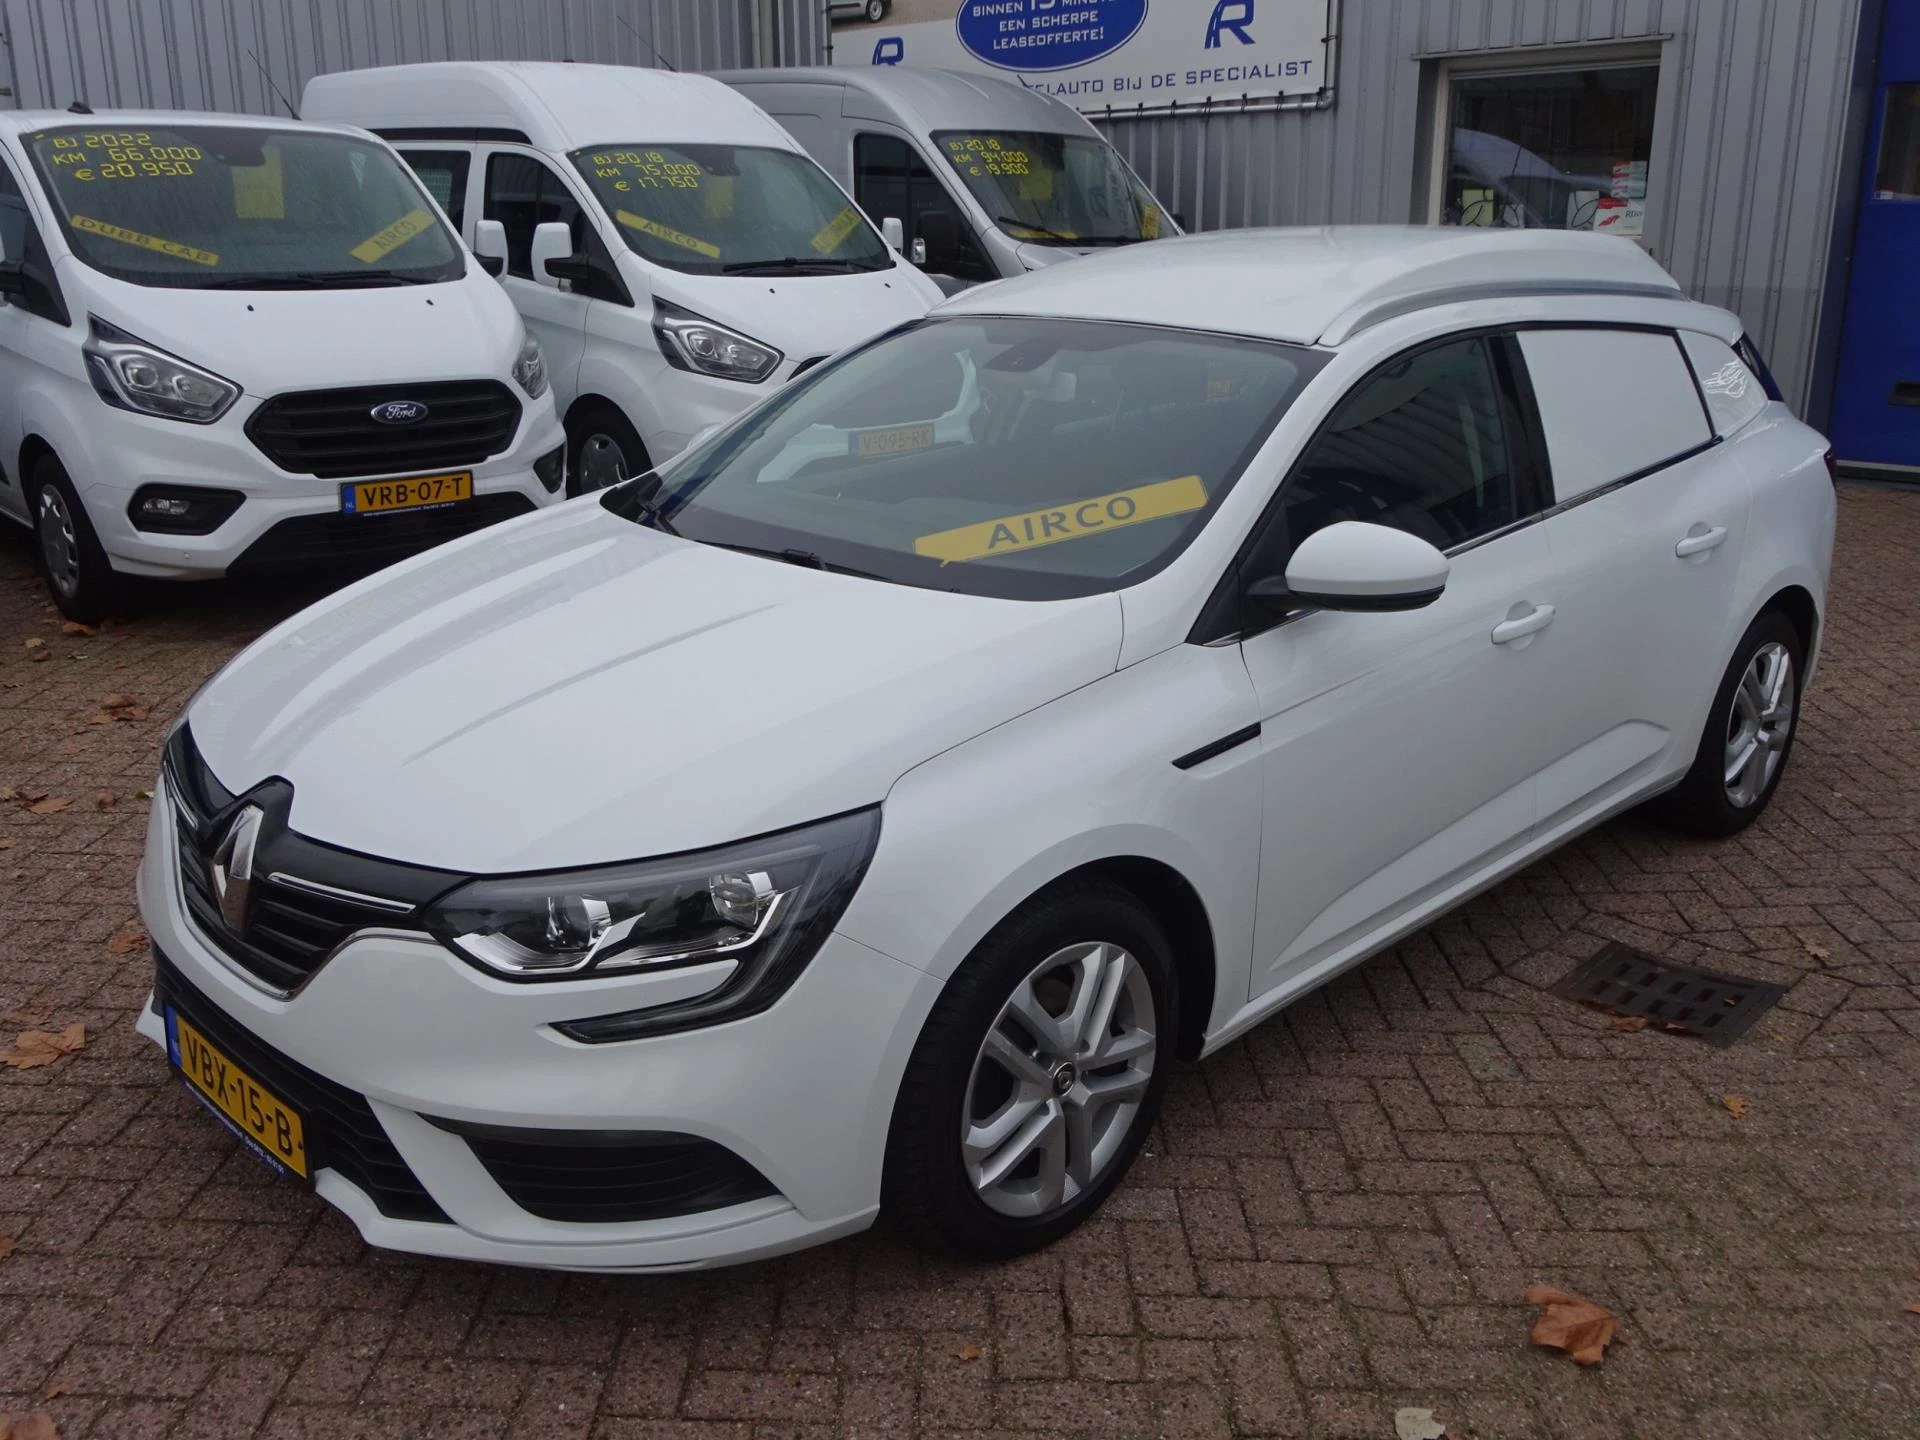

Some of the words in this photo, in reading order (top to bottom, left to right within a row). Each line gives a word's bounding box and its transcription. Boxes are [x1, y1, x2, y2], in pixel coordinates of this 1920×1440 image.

[973, 2, 1023, 17] BINNEN
[1000, 20, 1026, 32] EEN
[1032, 10, 1098, 29] SCHERPE
[993, 27, 1105, 50] LEASEOFFERTE!
[1113, 77, 1143, 91] BIJ
[1152, 73, 1176, 87] DE
[1186, 60, 1313, 85] SPECIALIST
[53, 137, 78, 149] BJ
[84, 133, 151, 148] 2022
[964, 139, 1001, 151] 2018
[53, 152, 87, 165] KM
[108, 147, 201, 161] 66.000
[593, 155, 612, 165] BJ
[614, 152, 663, 164] 2018
[953, 154, 972, 164] KM
[981, 151, 1029, 163] 94.000
[74, 169, 95, 181] €
[100, 162, 193, 178] 20.950
[595, 168, 621, 178] KM
[635, 163, 700, 176] 75.000
[969, 166, 982, 177] €
[985, 163, 1029, 175] 19.900
[615, 180, 631, 192] €
[638, 176, 698, 189] 17.750
[373, 220, 417, 250] AIRCO
[643, 222, 697, 248] AIRCO
[386, 404, 417, 419] Ford
[364, 478, 463, 506] VRB-07-T
[987, 496, 1137, 549] AIRCO
[184, 1029, 293, 1157] VBX-15-B
